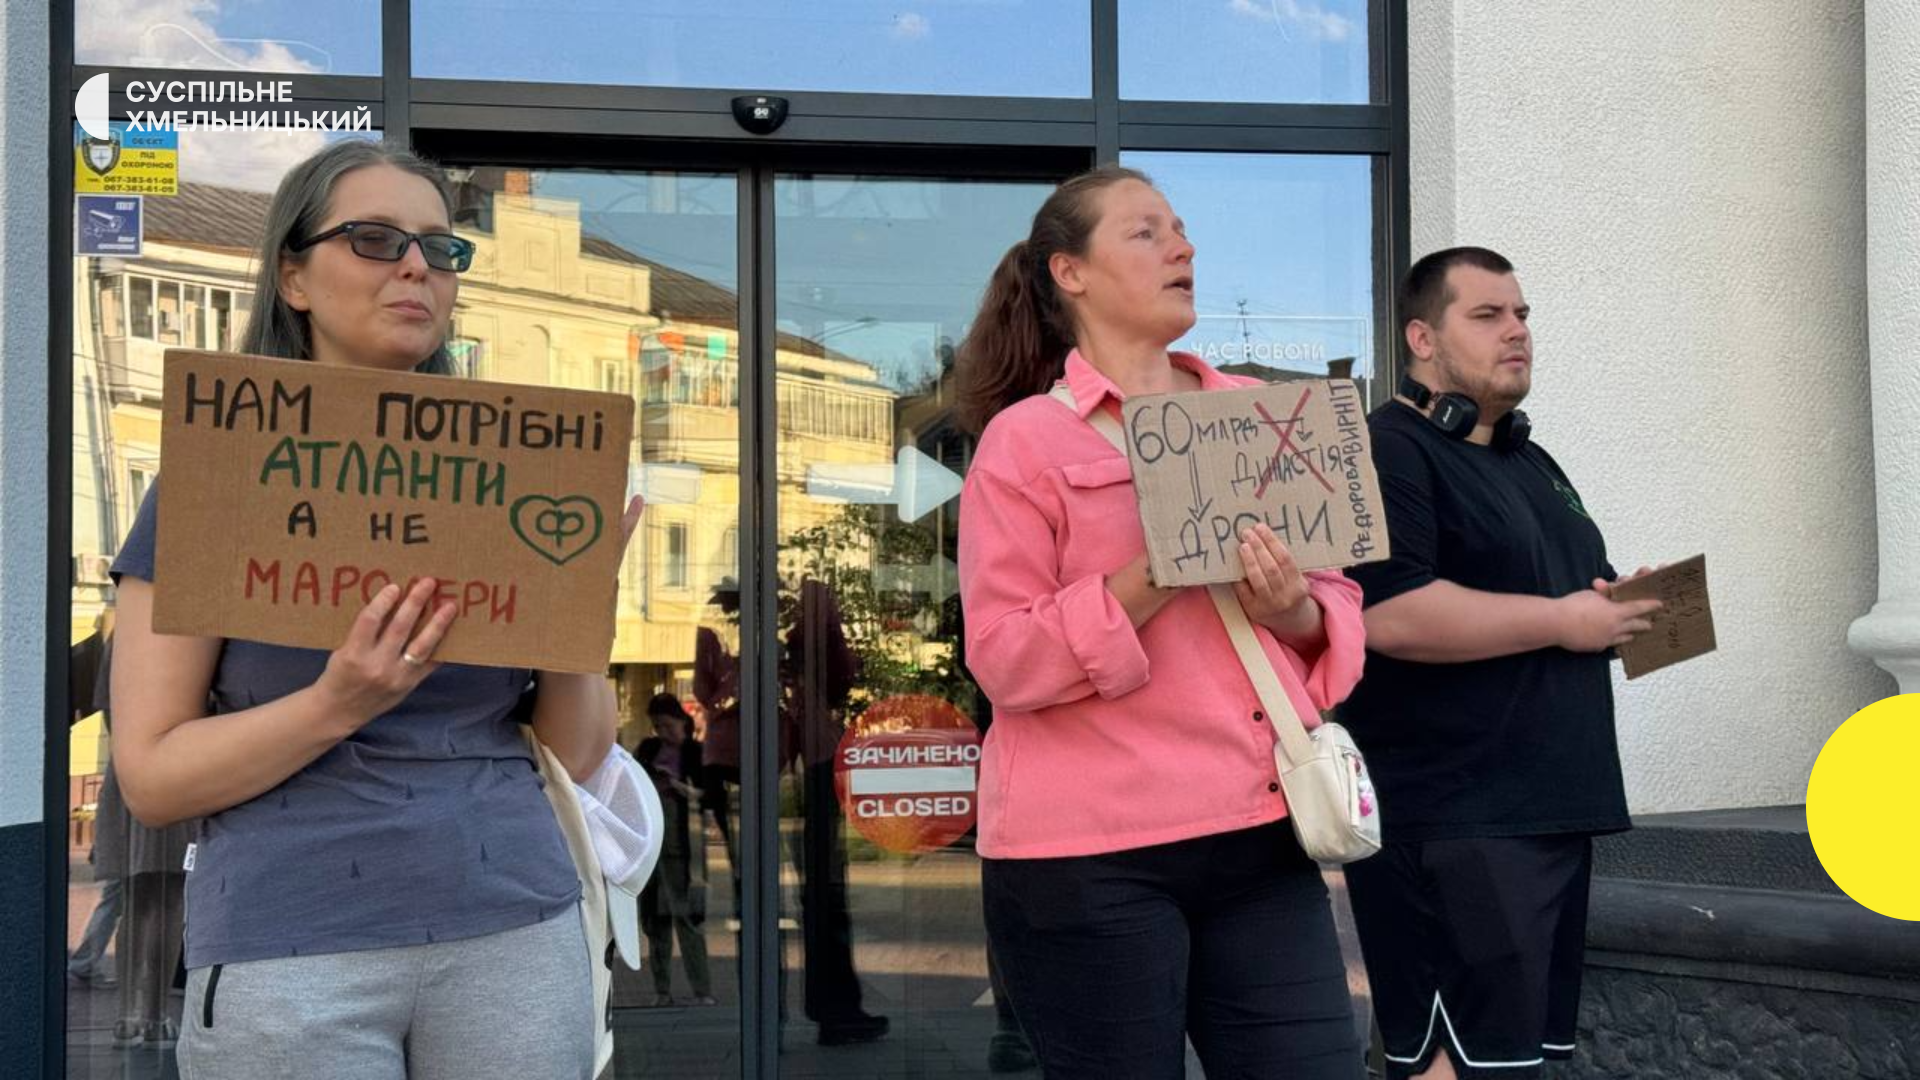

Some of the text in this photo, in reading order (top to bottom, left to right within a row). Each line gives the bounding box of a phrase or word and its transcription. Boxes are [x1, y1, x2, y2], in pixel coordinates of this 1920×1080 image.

[1190, 342, 1325, 360] ЧАС РОБОТИ
[184, 372, 313, 435] НАМ
[1131, 401, 1194, 464] 60
[259, 435, 507, 506] АТЛАНТИ
[287, 501, 430, 544] А НЕ
